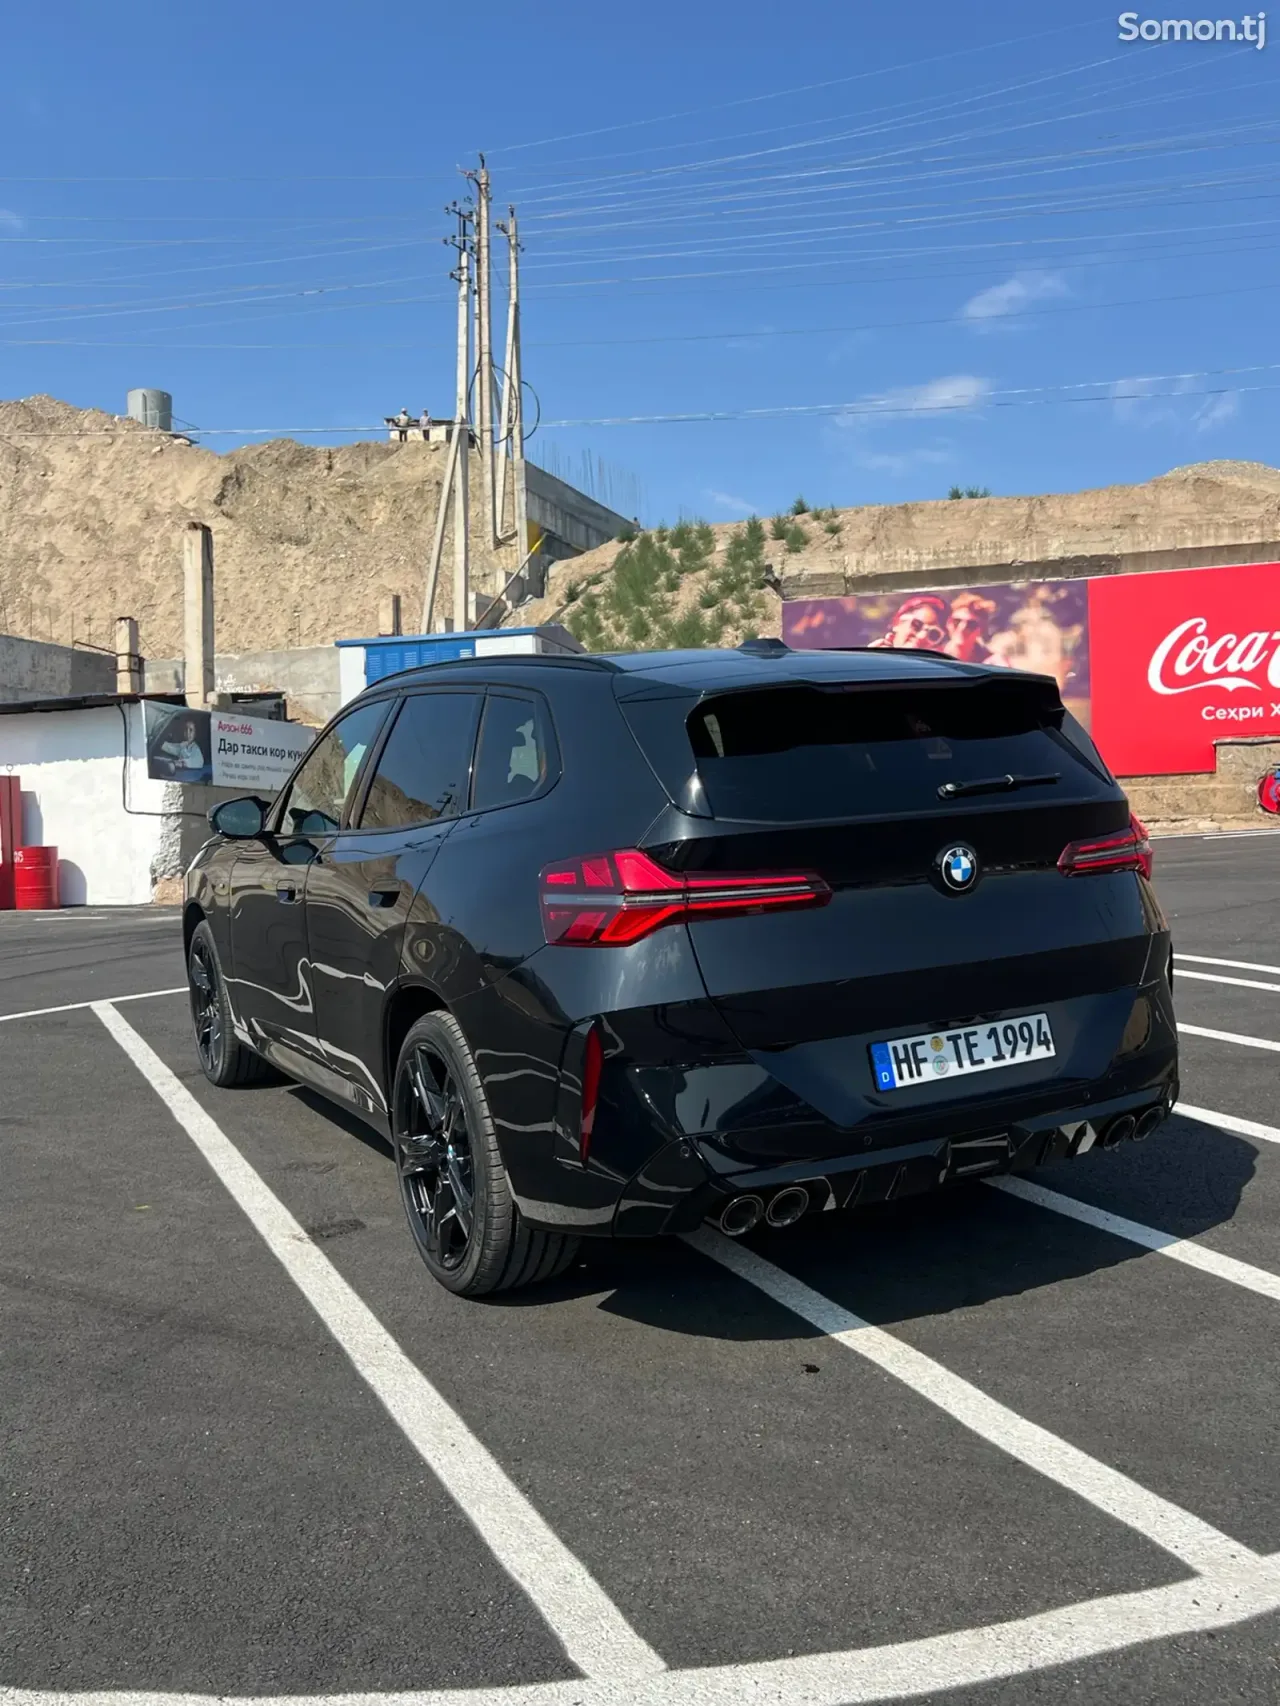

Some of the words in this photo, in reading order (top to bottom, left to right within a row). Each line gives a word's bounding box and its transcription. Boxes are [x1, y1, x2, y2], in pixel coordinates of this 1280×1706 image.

[218, 738, 239, 756] Дар
[241, 743, 268, 756] такси
[269, 747, 286, 760] кор
[892, 1040, 928, 1081] HF
[946, 1030, 985, 1069] TE
[987, 1018, 1052, 1063] 1994
[881, 1071, 890, 1083] D
